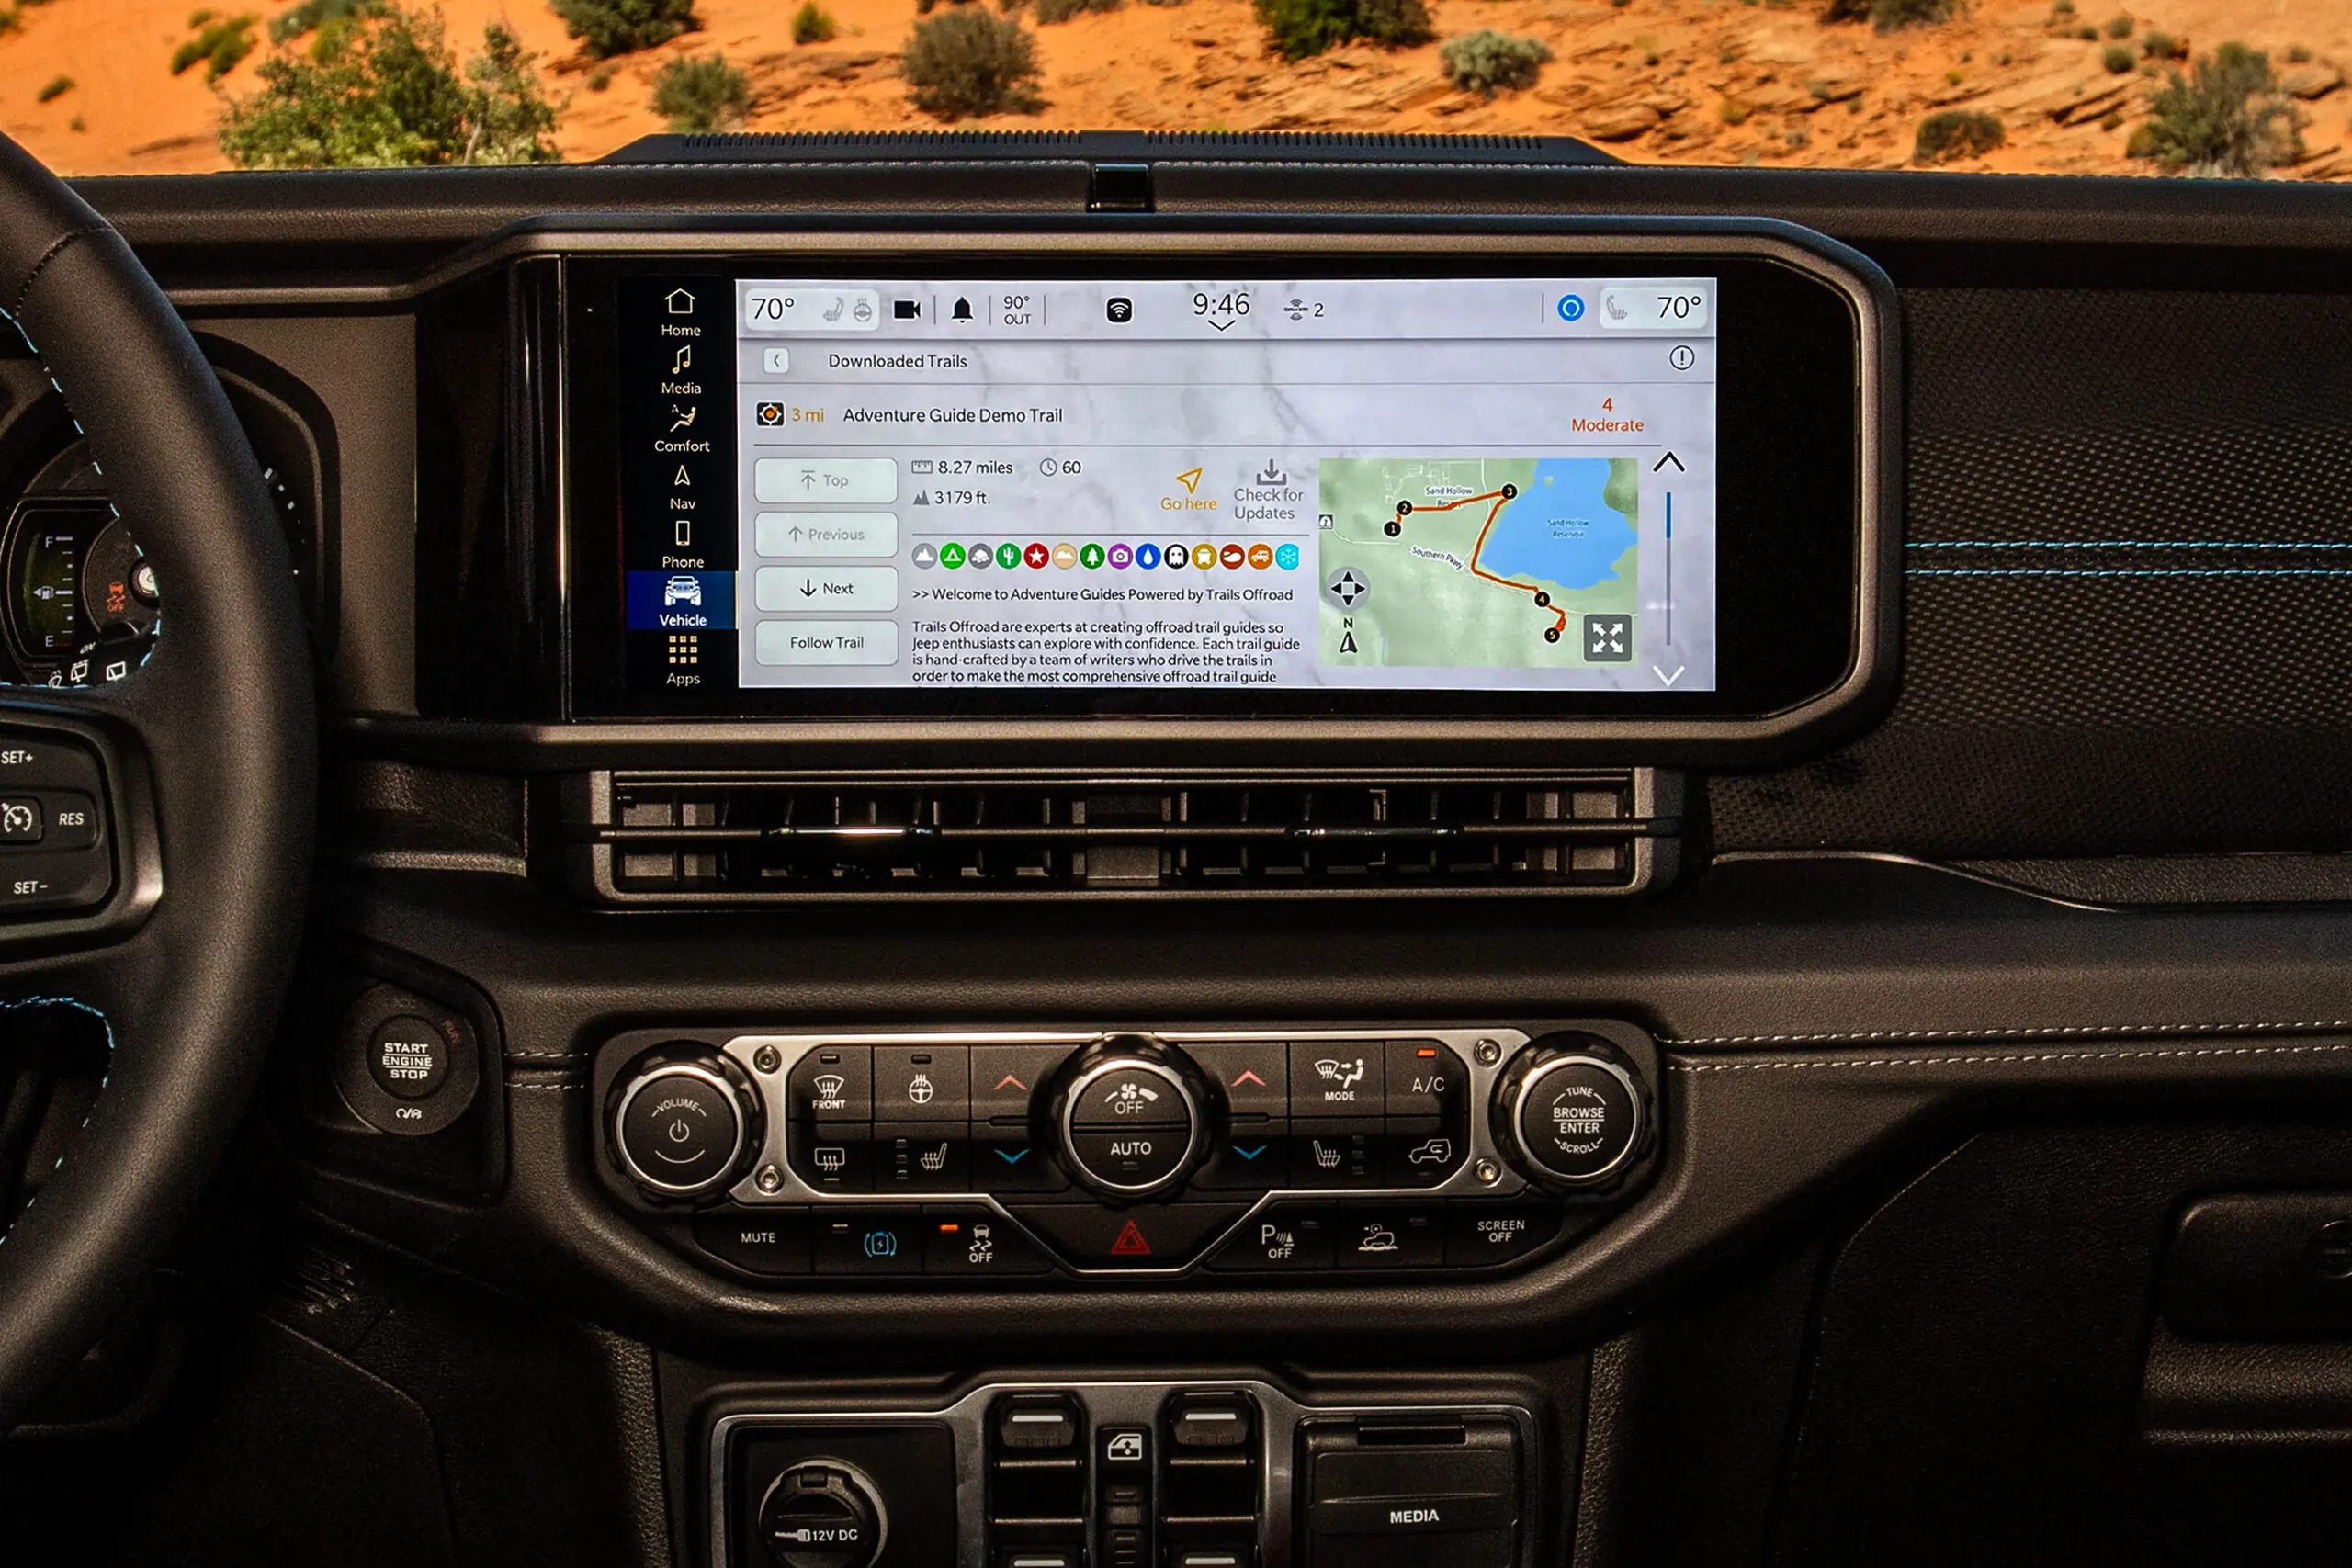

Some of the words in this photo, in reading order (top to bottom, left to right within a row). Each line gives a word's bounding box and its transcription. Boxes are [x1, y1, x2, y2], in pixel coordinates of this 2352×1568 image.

[752, 297, 795, 321] 70°
[1003, 295, 1030, 310] 90°
[1193, 293, 1250, 315] 9:46
[1657, 296, 1702, 319] 70°
[1314, 303, 1324, 317] 2
[1004, 313, 1031, 325] OUT
[662, 323, 700, 337] Home
[829, 354, 925, 368] Downloaded
[927, 354, 967, 368] Trails
[662, 381, 701, 395] Media
[1602, 399, 1612, 412] 4
[791, 408, 802, 423] 3
[805, 408, 825, 423] mi
[843, 407, 926, 423] Adventure
[929, 407, 976, 423] Guide
[979, 407, 1025, 423] Demo
[1029, 407, 1063, 423] Trail
[1572, 417, 1644, 433] Moderate
[654, 438, 710, 453] Comfort
[938, 461, 973, 475] 8.27
[976, 460, 1013, 475] miles
[1062, 461, 1082, 475] 60
[822, 473, 849, 490] Top
[934, 491, 972, 505] 3179
[976, 490, 990, 505] ft.
[1234, 488, 1281, 502] Check
[1285, 488, 1304, 502] for
[1426, 486, 1444, 495] Sand
[1507, 487, 1513, 496] 3
[670, 497, 695, 511] Nav
[1160, 497, 1181, 511] Go
[1185, 497, 1217, 510] here
[1401, 504, 1408, 513] 2
[1234, 506, 1295, 522] Updates
[808, 527, 865, 544] Previous
[1390, 525, 1396, 534] 1
[45, 537, 53, 548] F
[1412, 546, 1445, 561] Southern
[662, 555, 704, 569] Phone
[822, 581, 854, 596] Next
[932, 588, 992, 600] Welcome
[995, 588, 1009, 600] to
[1010, 588, 1078, 600] Adventure
[1080, 588, 1125, 600] Guides
[1128, 588, 1185, 601] Powered
[1187, 588, 1204, 604] by
[1206, 588, 1240, 601] Trails
[1243, 588, 1294, 601] Offroad
[1538, 595, 1545, 604] 4
[659, 613, 707, 628] Vehicle
[1343, 617, 1353, 629] N
[912, 621, 947, 633] Trails
[949, 621, 1000, 633] Offroad
[1002, 623, 1022, 633] are
[1025, 622, 1073, 635] experts
[1074, 622, 1087, 633] at
[1090, 621, 1142, 636] creating
[1145, 621, 1193, 634] offroad
[1195, 621, 1220, 634] trail
[1222, 621, 1266, 636] guides
[1268, 625, 1283, 634] so
[45, 636, 54, 647] E
[790, 636, 833, 650] Follow
[835, 636, 865, 650] Trail
[1549, 632, 1556, 640] 5
[912, 637, 939, 652] Jeep
[942, 637, 1016, 649] enthusiasts
[1018, 640, 1041, 649] can
[1044, 637, 1091, 652] explore
[1094, 637, 1123, 650] with
[1125, 637, 1199, 650] confidence.
[1202, 638, 1233, 650] Each
[1236, 638, 1261, 650] trail
[1264, 638, 1300, 653] guide
[912, 654, 923, 666] is
[926, 654, 1008, 666] hand-crafted
[1011, 654, 1027, 668] by
[1029, 656, 1037, 666] a
[1040, 654, 1072, 666] team
[1074, 654, 1087, 666] of
[1089, 654, 1135, 666] writers
[1137, 654, 1165, 666] who
[1168, 654, 1200, 666] drive
[1202, 654, 1224, 666] the
[1226, 654, 1257, 667] trails
[1261, 654, 1273, 667] in
[666, 671, 701, 688] Apps
[912, 670, 948, 682] order
[950, 671, 964, 682] to
[967, 670, 1001, 682] make
[1004, 670, 1025, 682] the
[1027, 671, 1060, 682] most
[1062, 670, 1160, 685] comprehensive
[1163, 670, 1210, 683] offroad
[1213, 670, 1238, 683] trail
[1240, 671, 1277, 685] guide
[0, 750, 34, 765] SET+
[58, 812, 85, 827] RES
[384, 1042, 429, 1054] START
[382, 1056, 433, 1067] ENGINE
[390, 1069, 429, 1080] STOP
[1411, 1077, 1446, 1093] A/C
[1566, 1086, 1594, 1098] TUNE
[1325, 1090, 1356, 1101] MODE
[657, 1097, 699, 1113] VOLUME
[812, 1099, 846, 1110] FRONT
[1114, 1101, 1144, 1116] OFF
[1553, 1106, 1605, 1118] BROWSE
[1560, 1122, 1600, 1135] ENTER
[1110, 1141, 1153, 1156] AUTO
[1560, 1139, 1600, 1156] SCROLL
[1477, 1220, 1526, 1232] SCREEN
[741, 1232, 776, 1244] MUTE
[1261, 1224, 1275, 1244] P
[1488, 1232, 1513, 1243] OFF
[968, 1252, 994, 1264] OFF
[1267, 1247, 1293, 1260] OFF
[1389, 1507, 1440, 1525] MEDIA
[811, 1529, 835, 1542] 12V
[838, 1528, 859, 1542] DC
